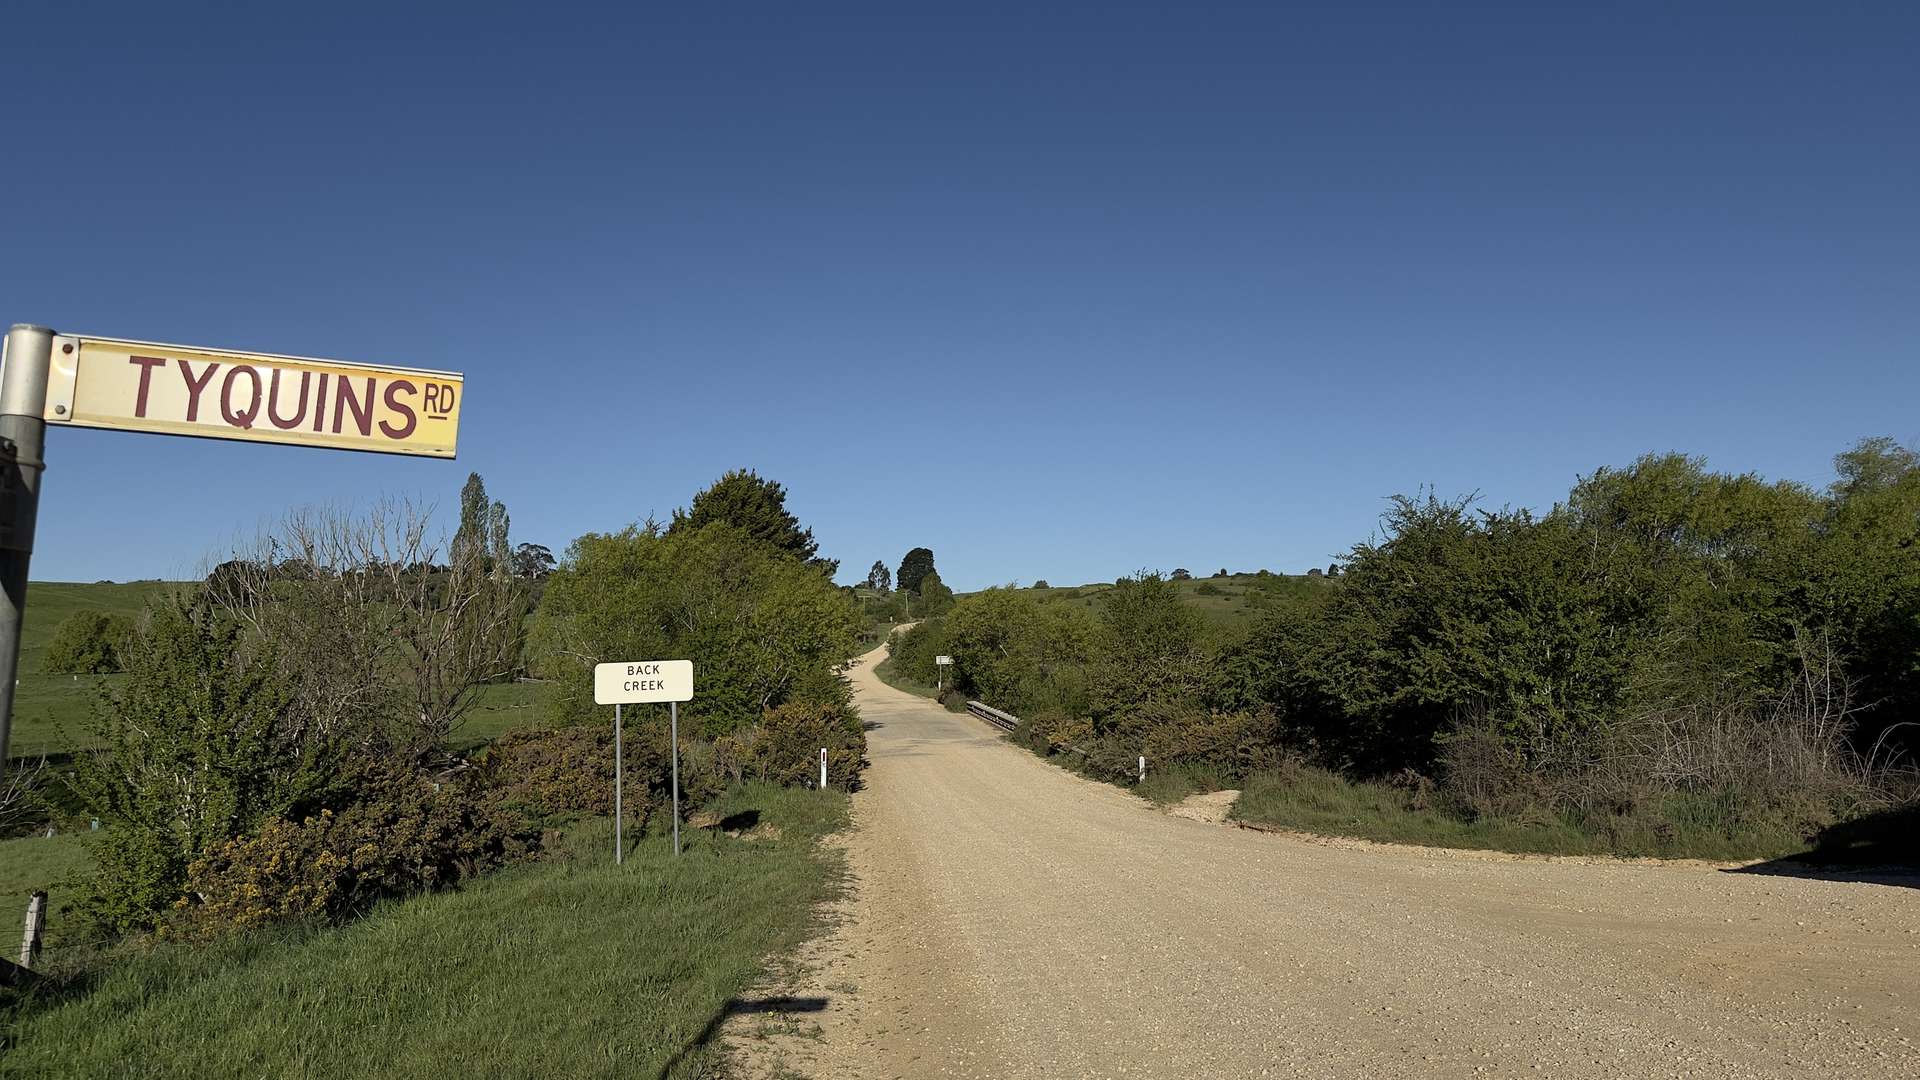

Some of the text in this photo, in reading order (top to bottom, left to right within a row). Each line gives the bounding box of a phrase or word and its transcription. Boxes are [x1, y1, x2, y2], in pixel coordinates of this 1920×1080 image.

[129, 355, 455, 440] TYQUINS RD
[627, 664, 660, 675] BACK
[623, 680, 665, 692] CREEK
